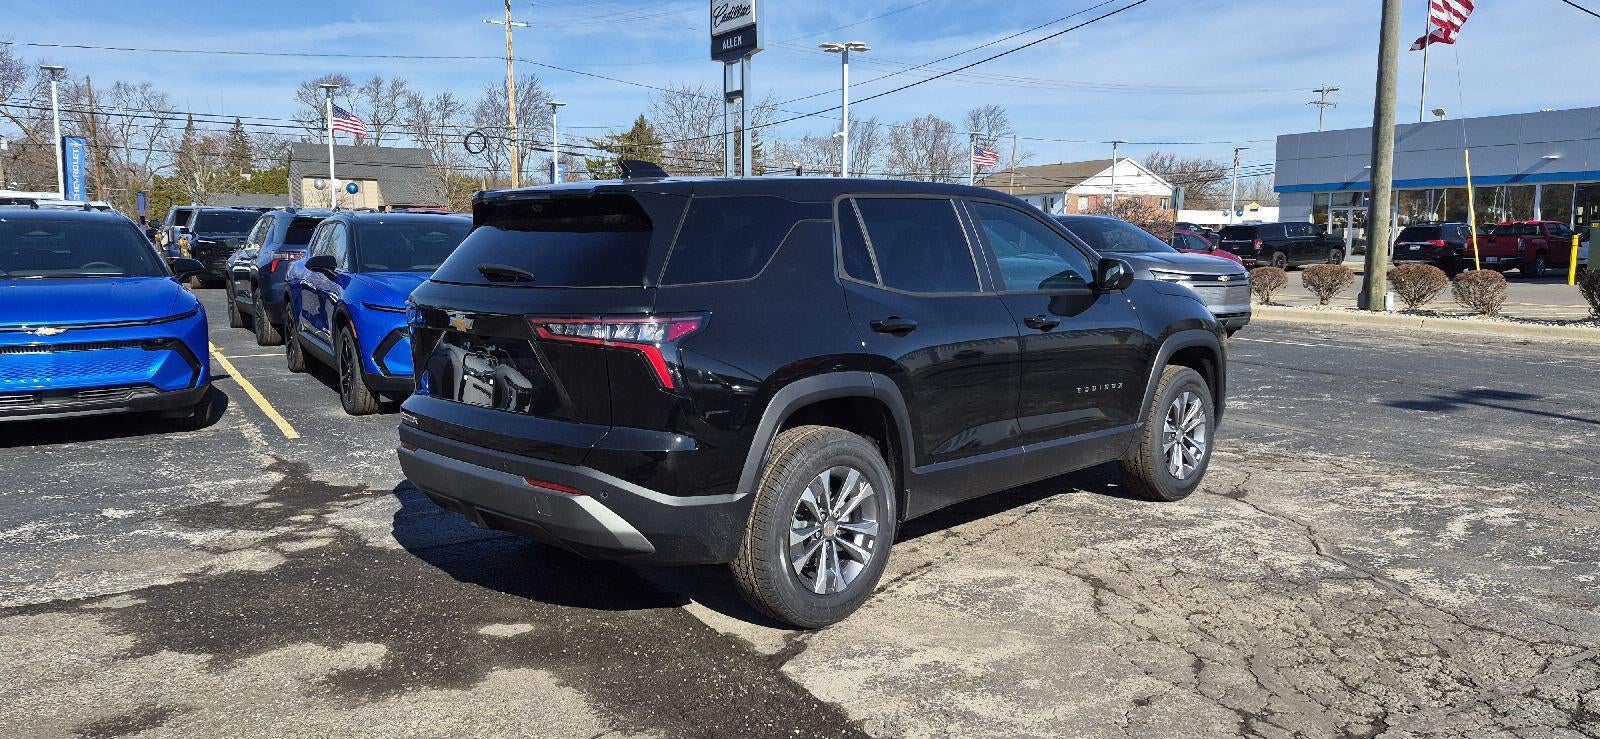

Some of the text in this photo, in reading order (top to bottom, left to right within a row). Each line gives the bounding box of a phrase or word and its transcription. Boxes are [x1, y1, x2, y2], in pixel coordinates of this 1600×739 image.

[713, 3, 751, 27] Cadillac
[722, 35, 742, 49] ALLEN
[1076, 382, 1122, 393] EQUINOX
